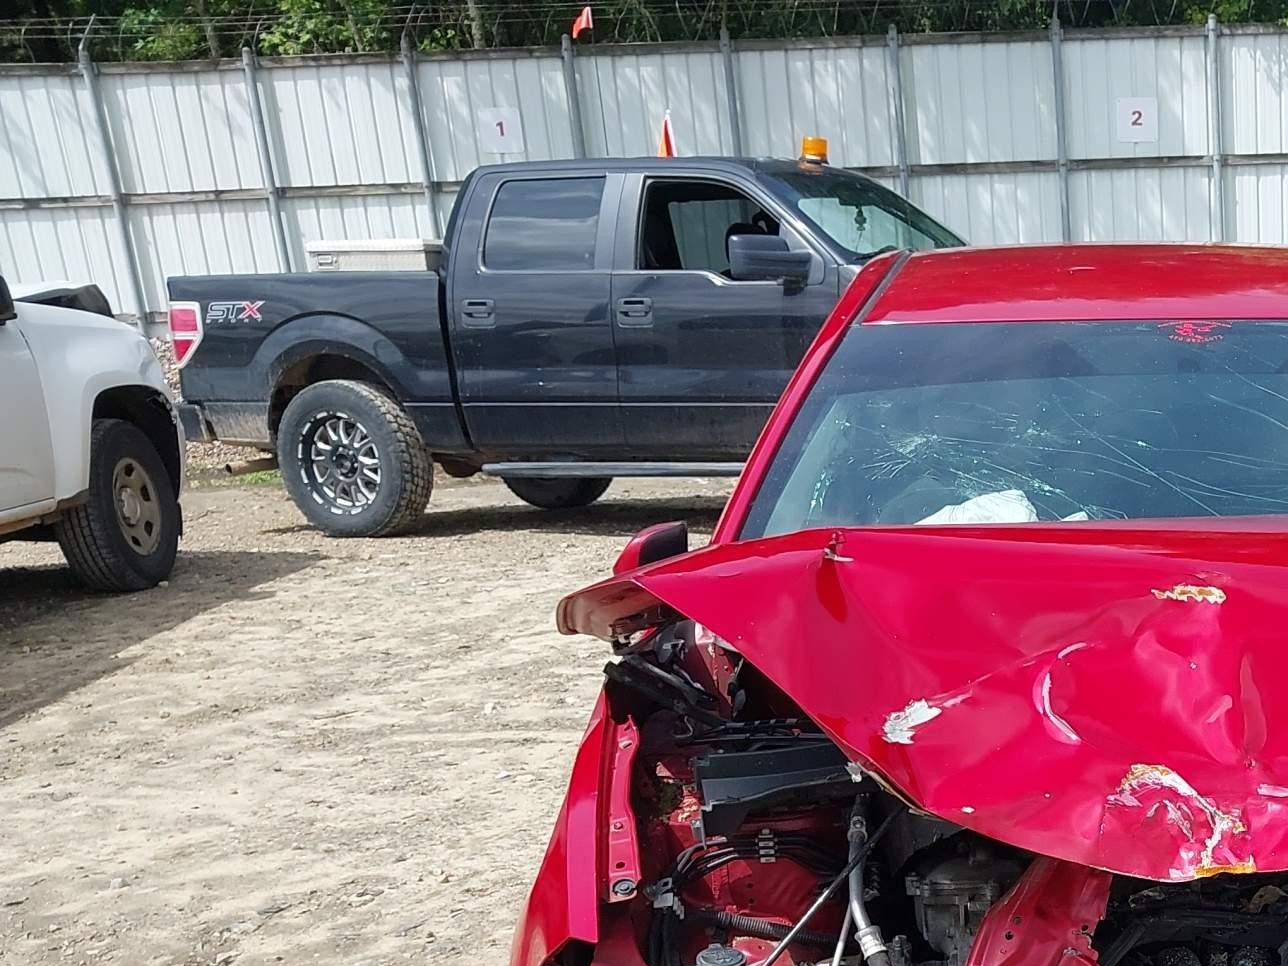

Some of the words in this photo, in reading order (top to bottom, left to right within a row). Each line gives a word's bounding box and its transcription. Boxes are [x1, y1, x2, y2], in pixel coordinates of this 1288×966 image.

[1131, 110, 1143, 126] 2
[495, 120, 505, 137] 1
[205, 300, 266, 319] STX
